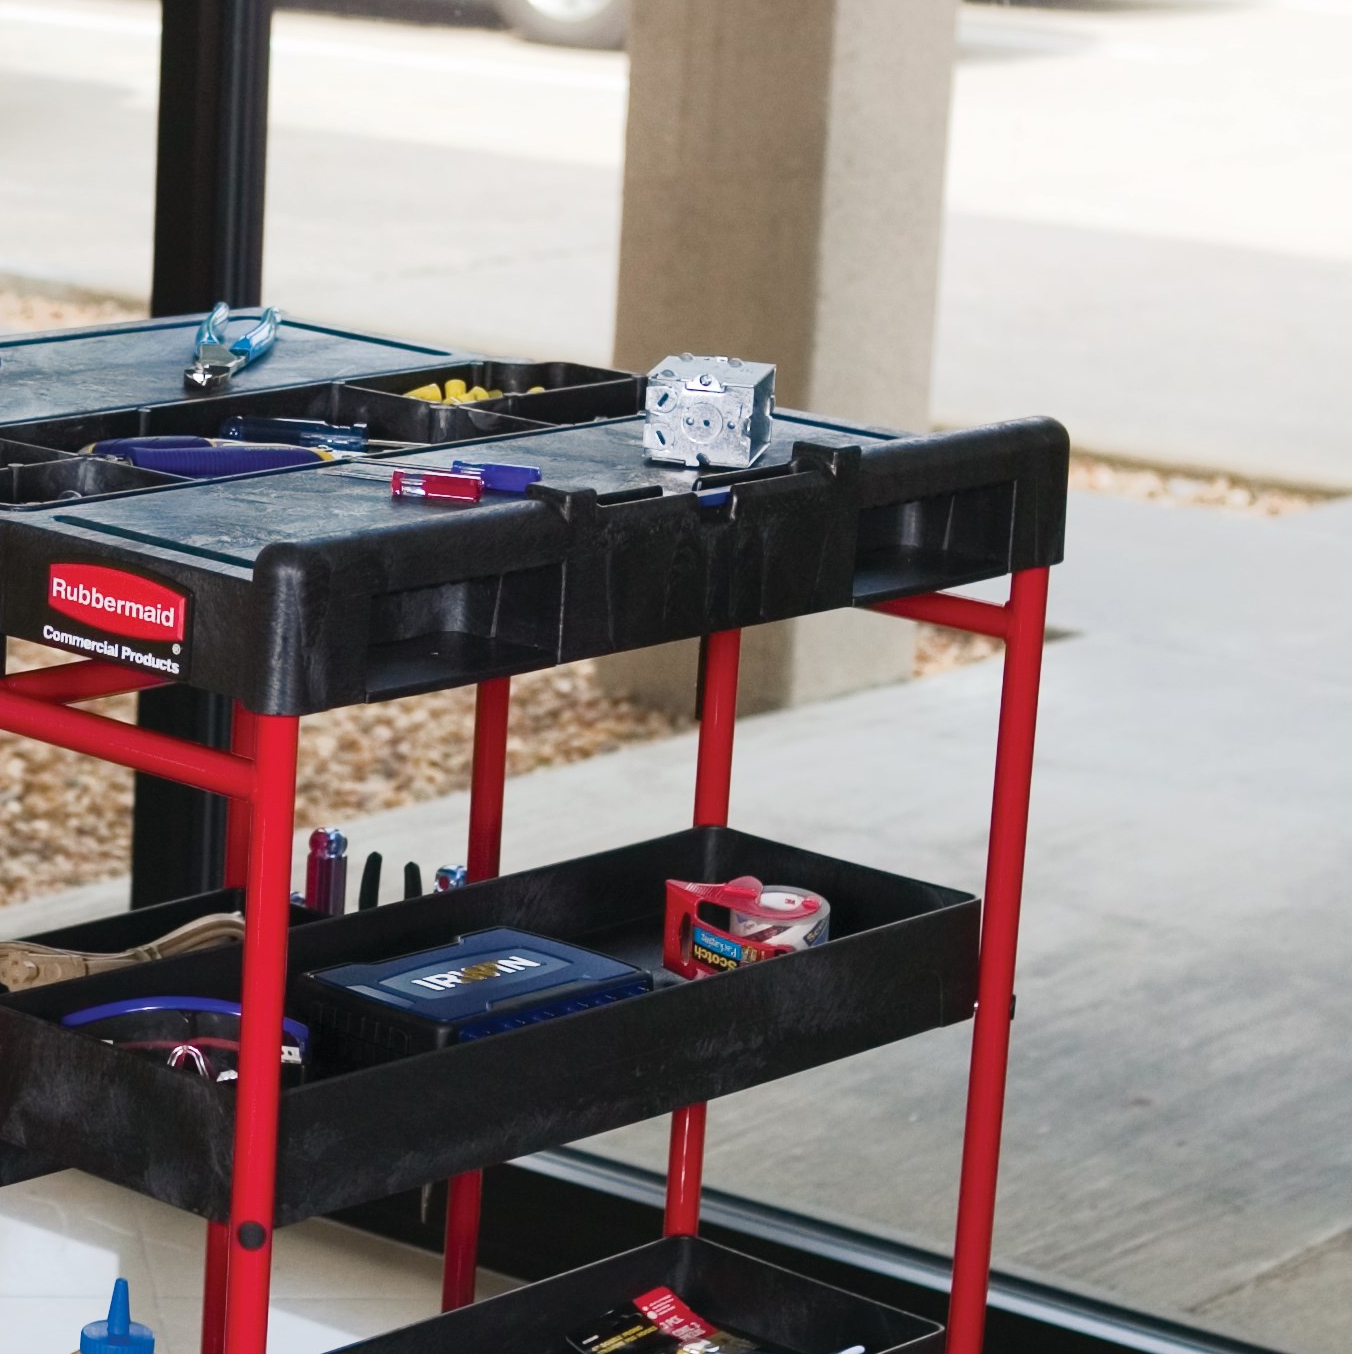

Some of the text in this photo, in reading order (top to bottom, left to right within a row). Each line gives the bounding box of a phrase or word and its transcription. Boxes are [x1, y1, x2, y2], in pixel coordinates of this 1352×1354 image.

[52, 577, 175, 628] Rubbermaid
[43, 624, 180, 674] Commercial Products
[411, 955, 541, 991] IRWIN
